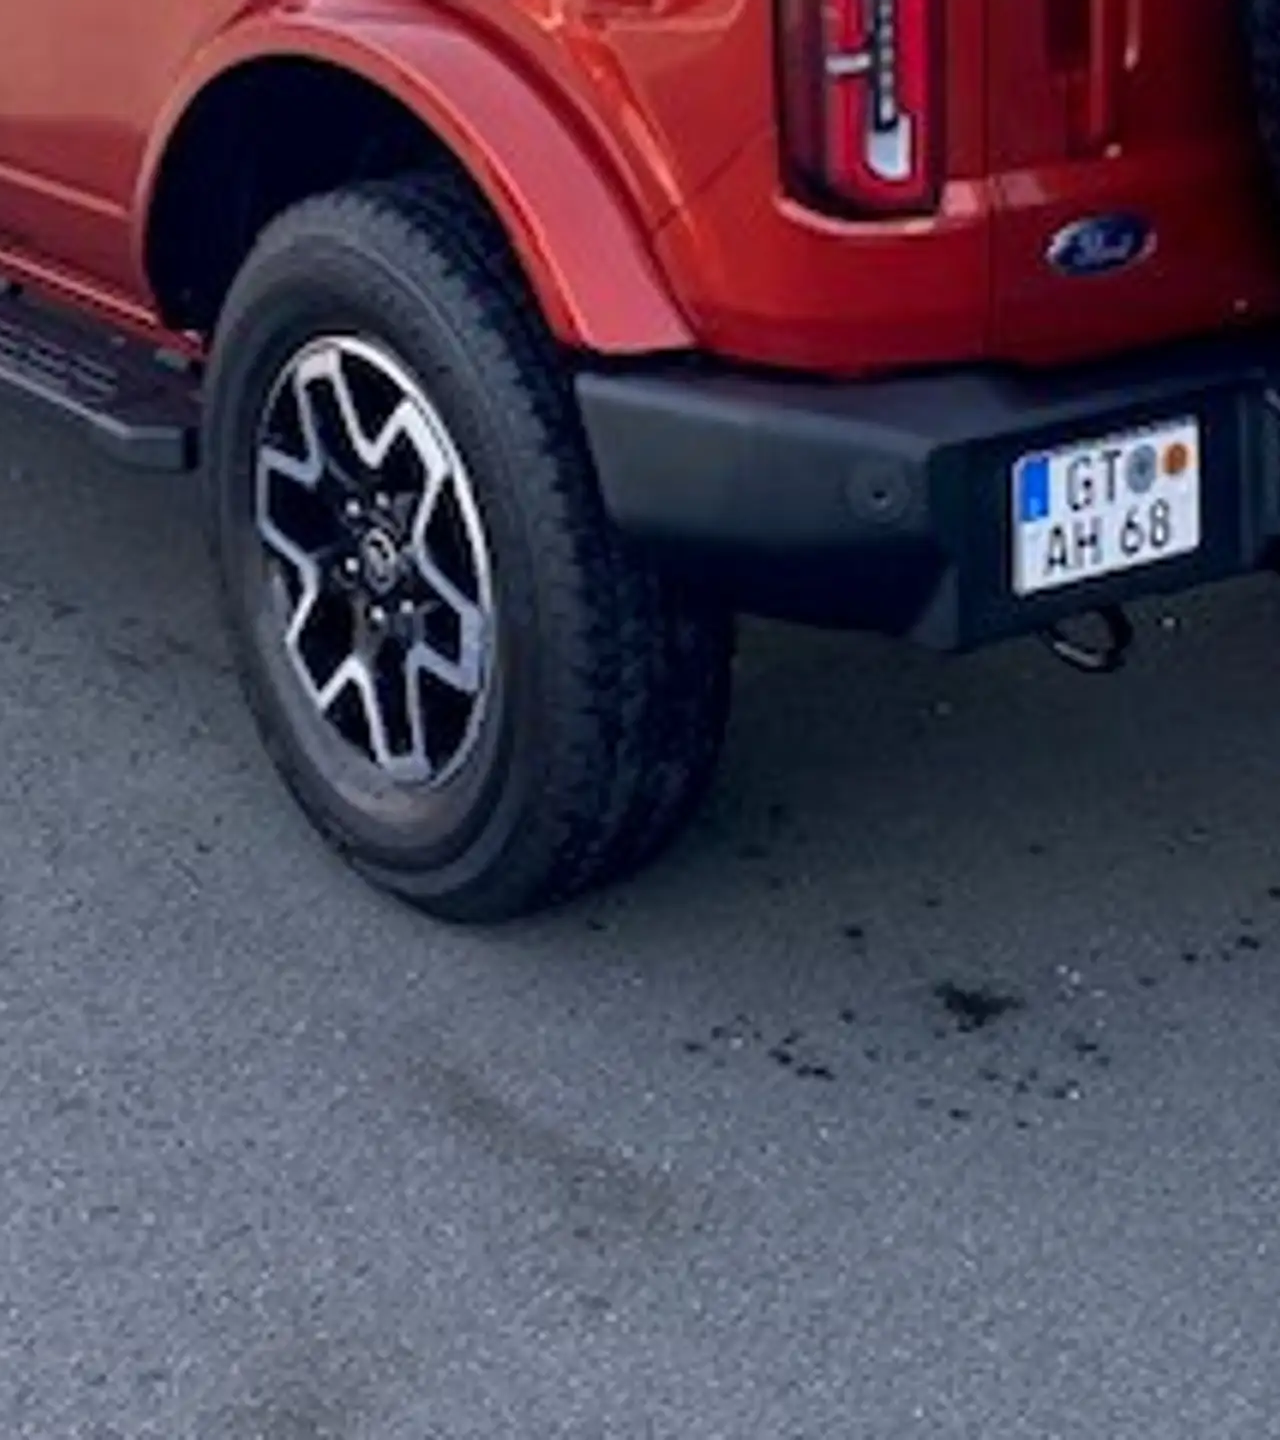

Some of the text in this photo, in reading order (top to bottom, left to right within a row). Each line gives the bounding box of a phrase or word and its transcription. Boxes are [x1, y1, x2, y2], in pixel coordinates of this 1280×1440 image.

[1066, 448, 1122, 512] GT
[1043, 497, 1171, 577] AH 68
